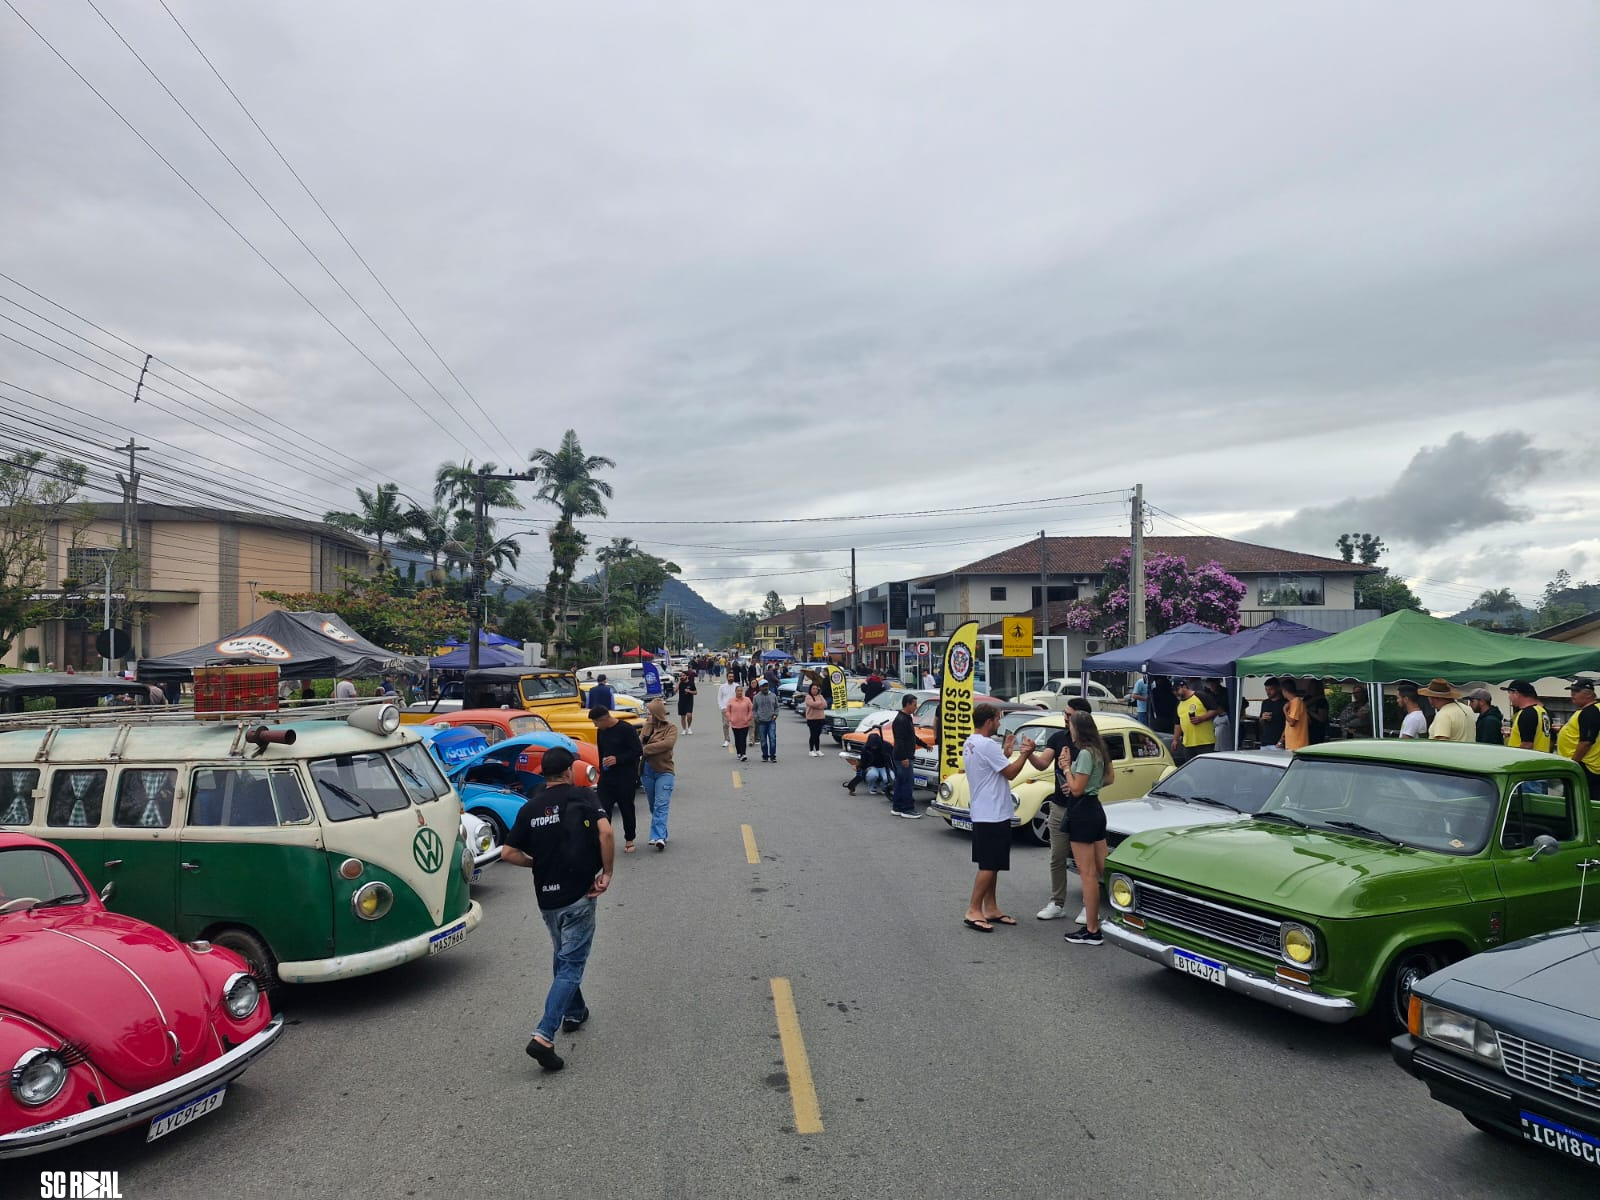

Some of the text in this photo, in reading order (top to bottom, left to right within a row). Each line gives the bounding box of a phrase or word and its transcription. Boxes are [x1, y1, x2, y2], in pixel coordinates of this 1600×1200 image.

[944, 687, 959, 769] ANTIGOS
[957, 688, 972, 757] MIGOS
[1178, 957, 1220, 982] BTC4J71
[156, 1095, 217, 1137] LYC9F19
